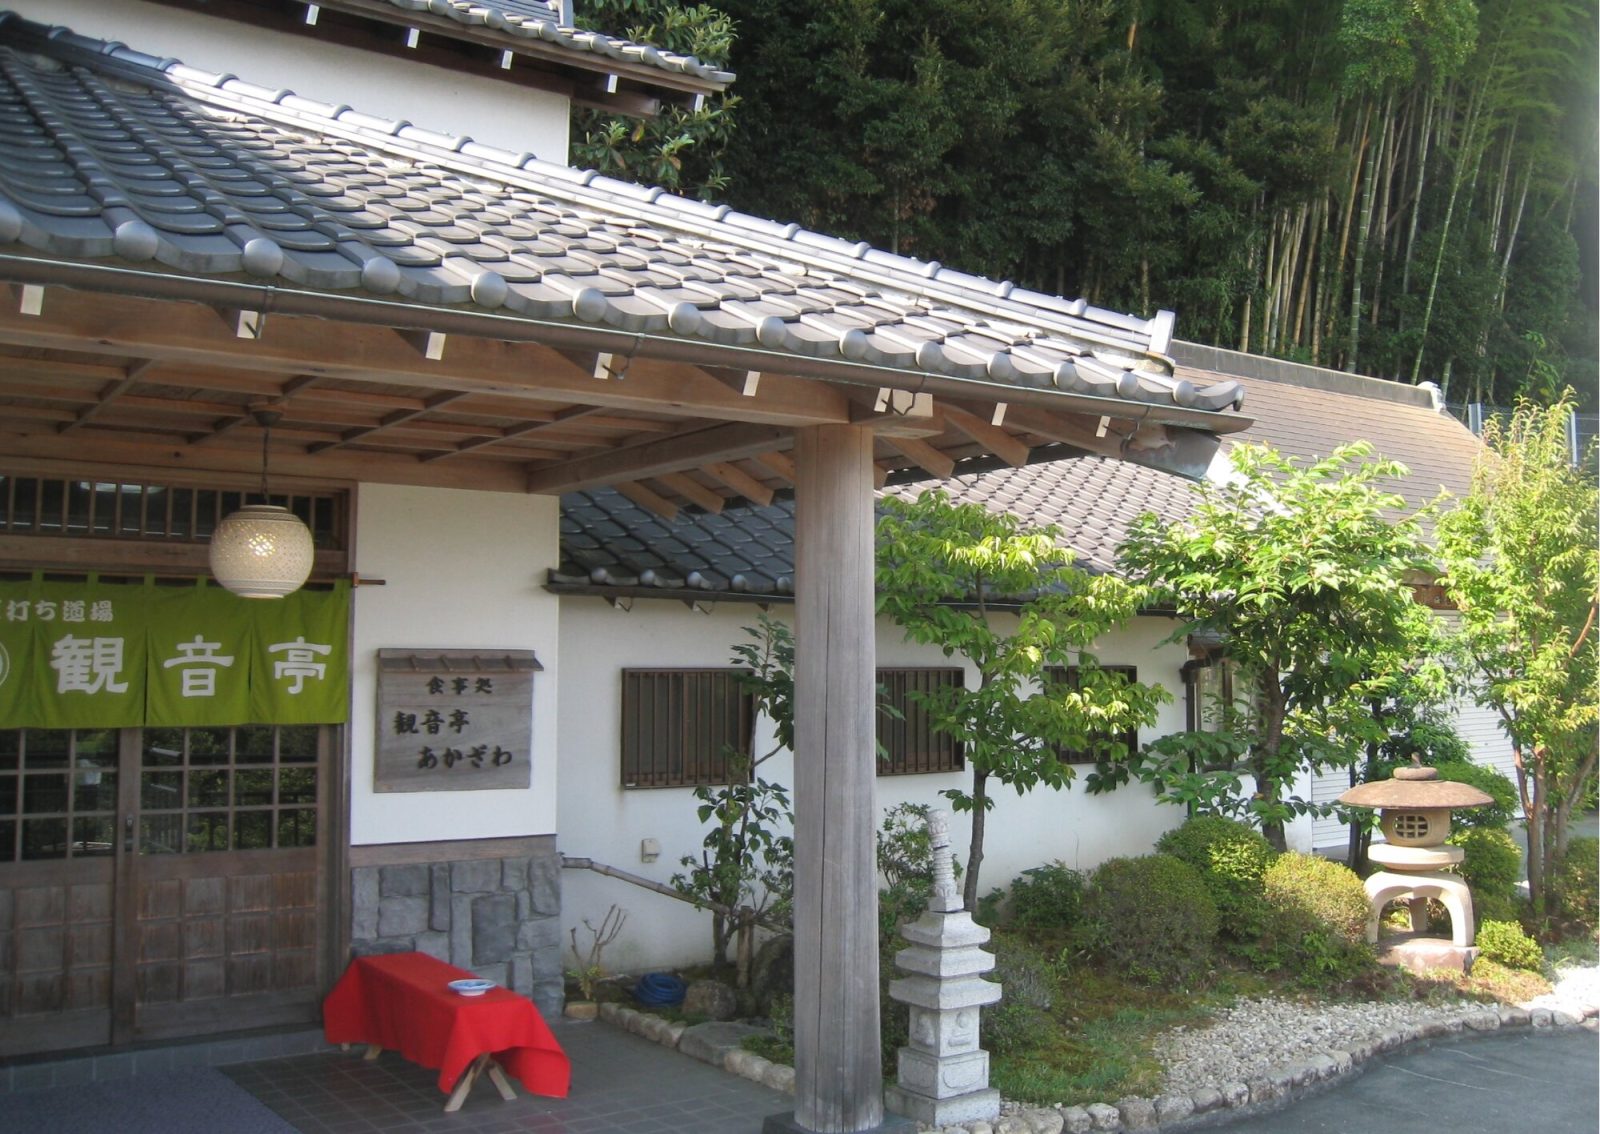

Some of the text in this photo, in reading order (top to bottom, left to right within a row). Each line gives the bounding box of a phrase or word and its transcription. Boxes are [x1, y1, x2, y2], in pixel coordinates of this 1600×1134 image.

[0, 599, 114, 622] 打ち道場
[49, 633, 332, 698] 観音亭
[426, 676, 493, 695] 食事処
[393, 708, 470, 735] 観音亭
[417, 744, 513, 769] あかざわ
